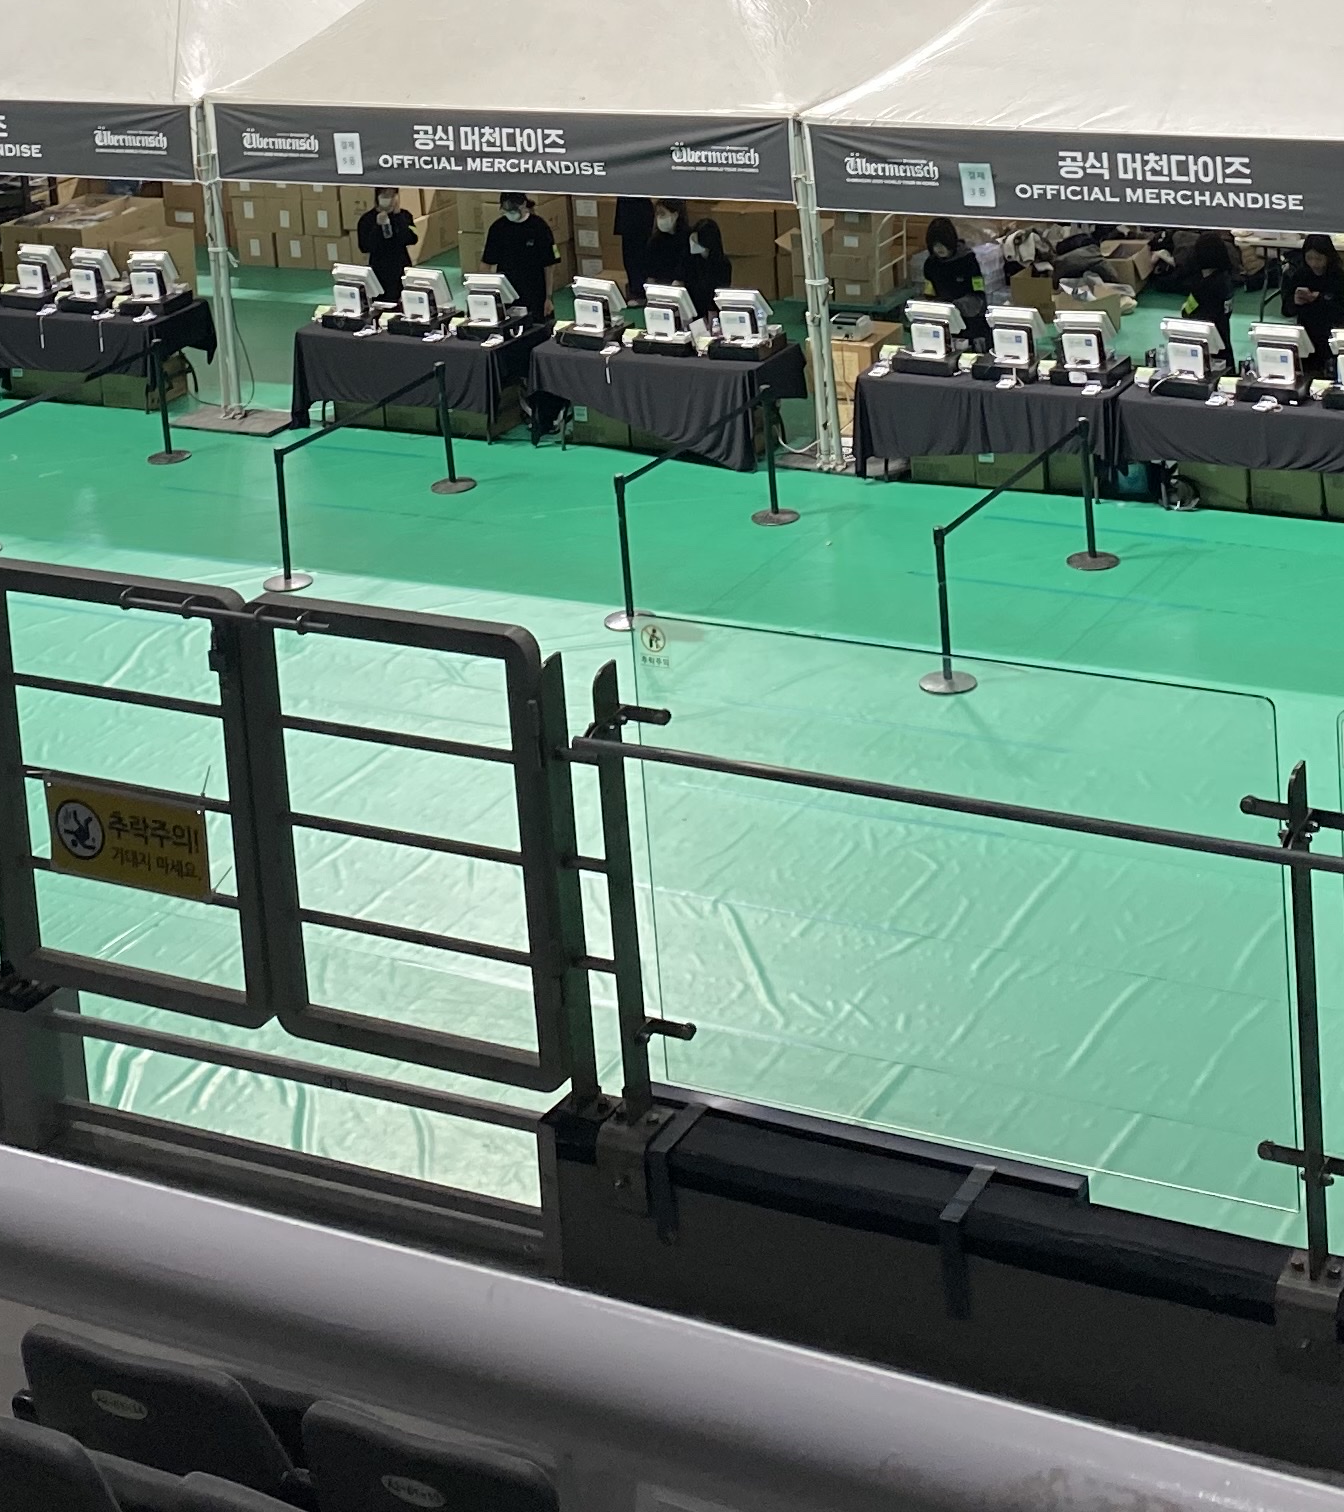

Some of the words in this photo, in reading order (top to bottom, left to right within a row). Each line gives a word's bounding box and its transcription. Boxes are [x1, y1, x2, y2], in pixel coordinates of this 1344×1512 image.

[413, 125, 455, 150] 공식
[459, 126, 566, 154] 머천다이즈
[378, 154, 462, 171] OFFICIAL
[467, 157, 606, 176] MERCHANDISE
[844, 152, 940, 180] Übermensch
[1057, 150, 1109, 180] 공식
[1116, 152, 1253, 185] 머천다이즈
[1015, 183, 1120, 203] OFFICIAL
[1125, 187, 1304, 211] MERCHANDISE
[108, 810, 199, 854] 추락주의!
